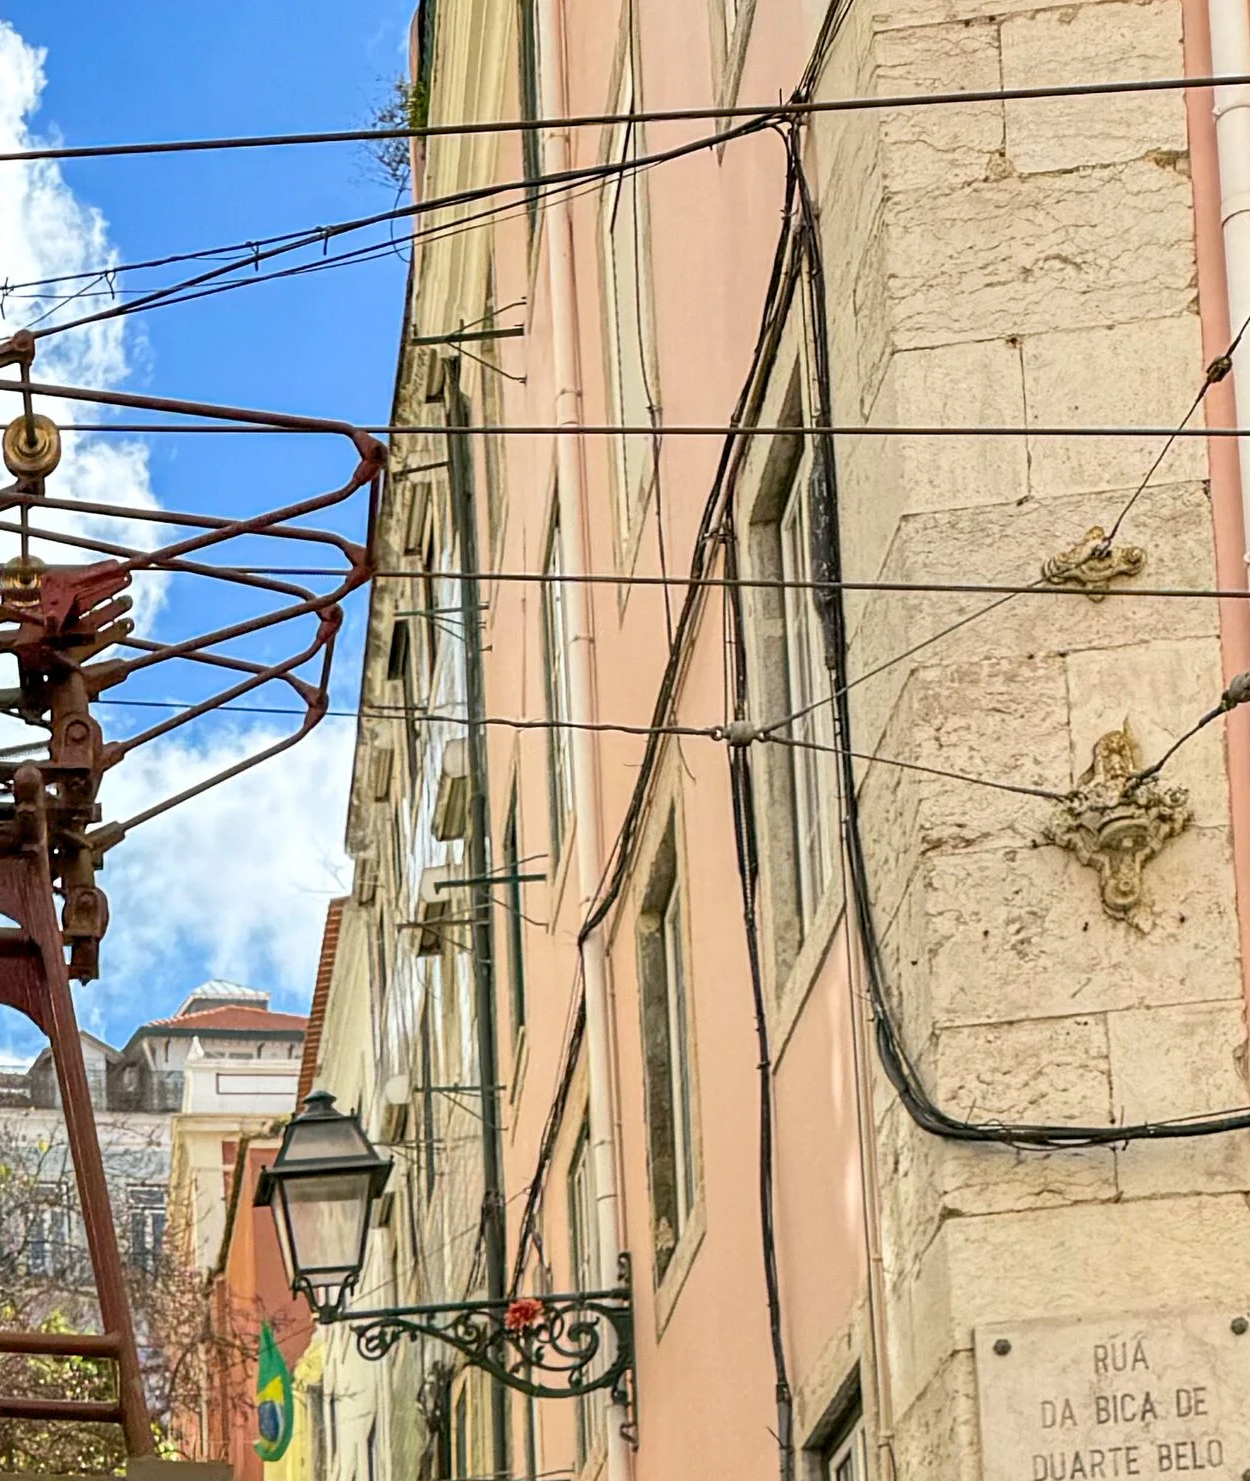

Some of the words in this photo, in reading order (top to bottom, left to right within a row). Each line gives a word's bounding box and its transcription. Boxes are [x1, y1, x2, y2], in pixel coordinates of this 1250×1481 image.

[1093, 1340, 1150, 1375] RUA
[1040, 1399, 1078, 1429] DA
[1095, 1392, 1158, 1425] BICA
[1176, 1387, 1209, 1418] DE
[1157, 1439, 1224, 1473] BELO
